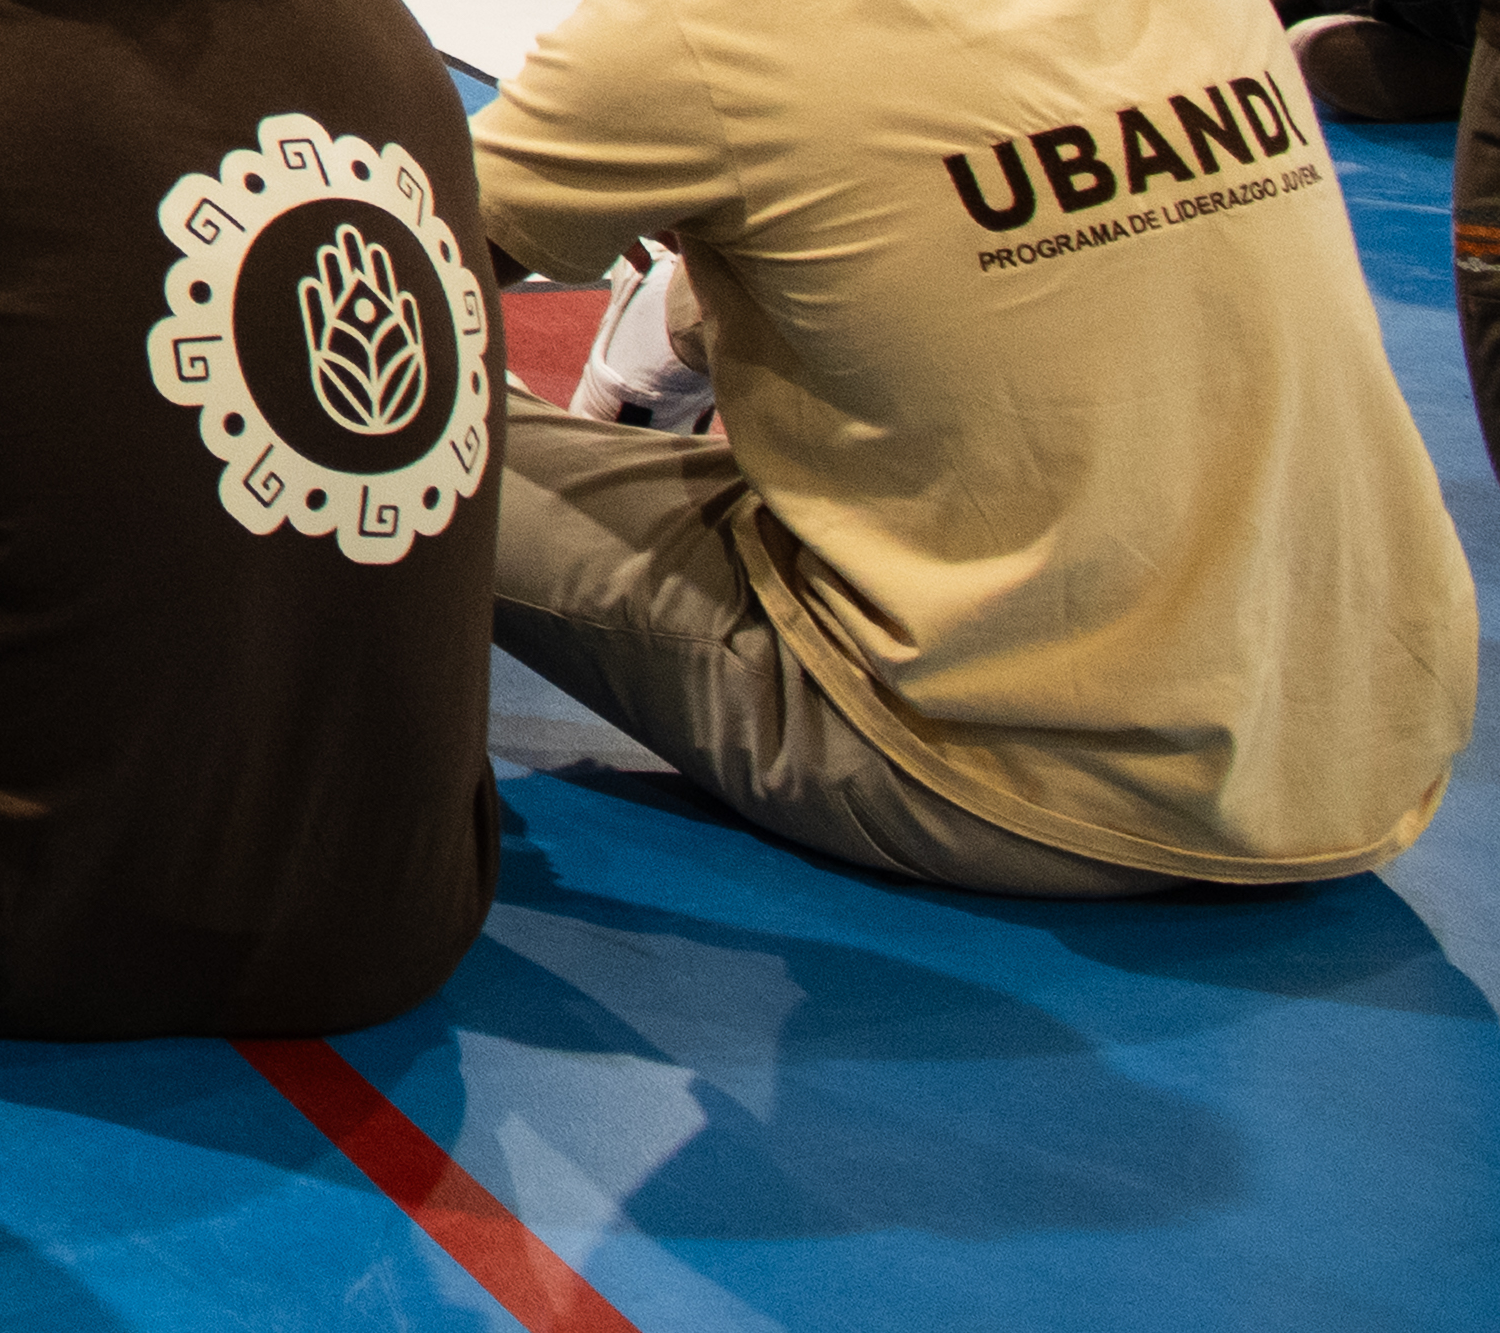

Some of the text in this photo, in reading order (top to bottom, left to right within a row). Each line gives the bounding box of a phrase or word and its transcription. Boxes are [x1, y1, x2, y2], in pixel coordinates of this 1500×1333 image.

[942, 70, 1309, 233] UBANDI
[978, 219, 1130, 272] PROGRAMA
[1130, 210, 1162, 236] DE
[1161, 177, 1278, 226] LIDERAZGO
